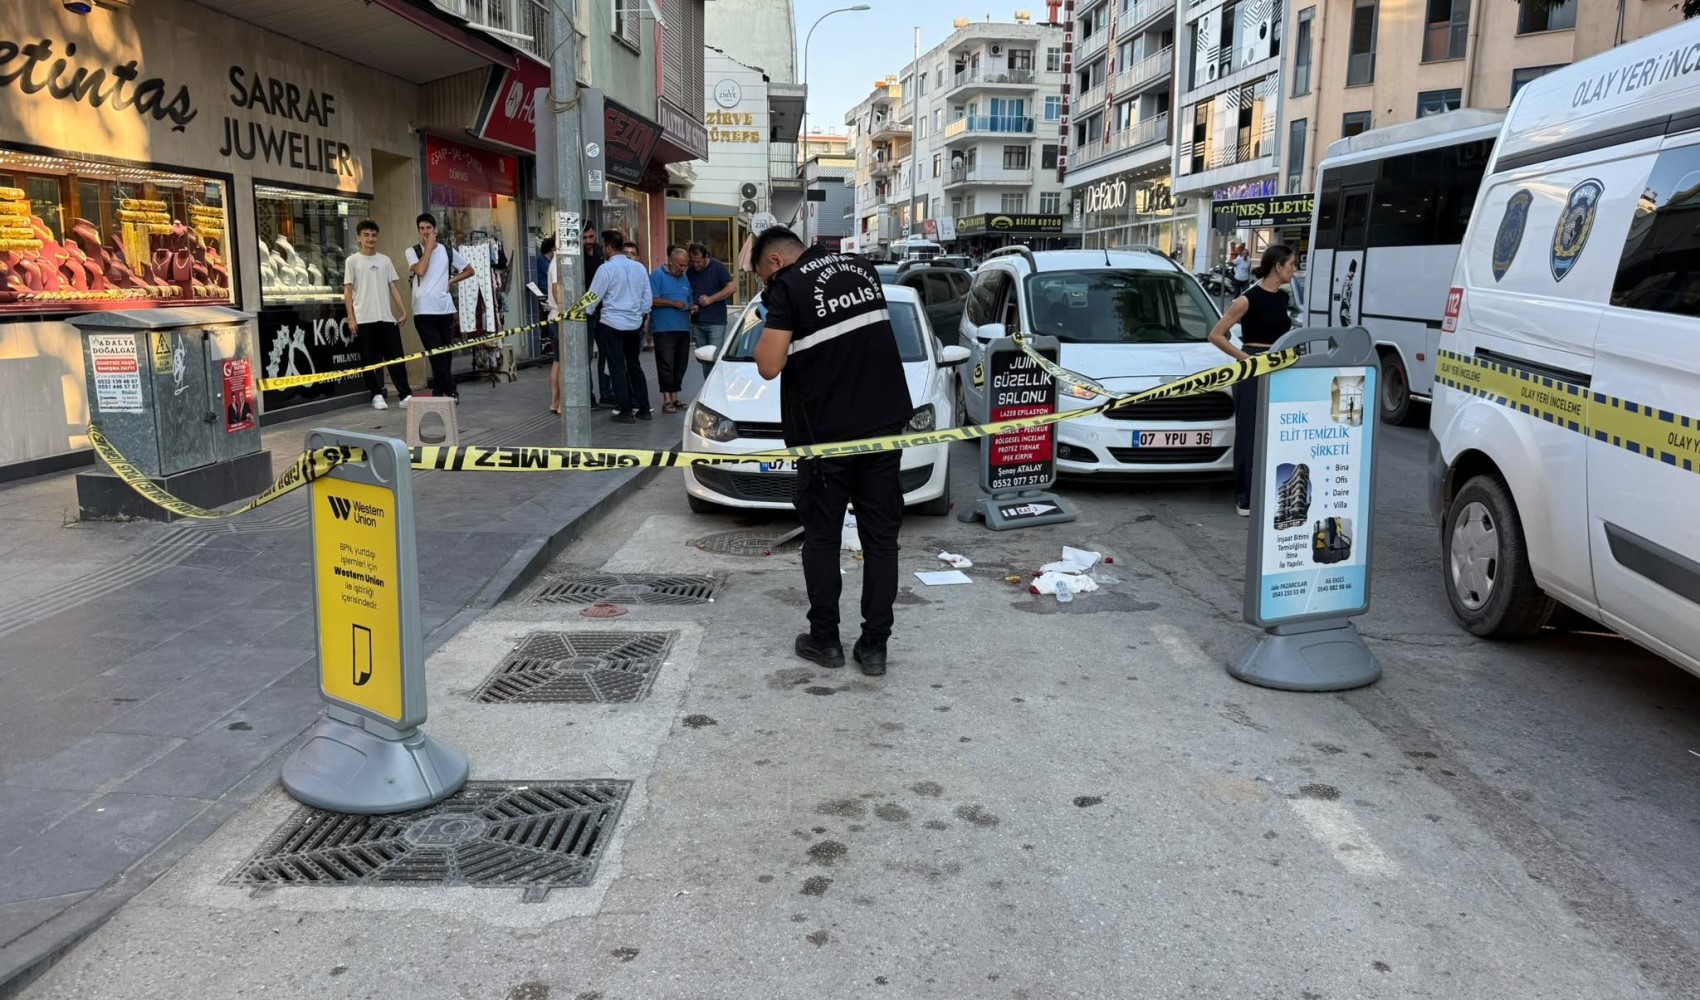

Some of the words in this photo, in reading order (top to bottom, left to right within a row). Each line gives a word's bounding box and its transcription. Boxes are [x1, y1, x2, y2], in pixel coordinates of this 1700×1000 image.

[1571, 70, 1619, 108] OLAY
[1617, 54, 1663, 94] YERİ
[229, 65, 336, 128] SARRAF
[706, 109, 753, 125] ZİRVE
[709, 126, 760, 144] ÜNEFE
[219, 117, 354, 178] JUWELIER
[1086, 177, 1126, 213] DeFacto
[816, 264, 838, 285] YERİ
[837, 263, 882, 299] İNCELEME
[814, 286, 827, 317] OLAY
[828, 286, 875, 313] POLİS
[92, 346, 136, 354] DOĞALGAZ
[994, 371, 1052, 388] GÜZELLİK
[998, 390, 1047, 405] SALONU
[1521, 386, 1536, 400] OLAY
[1536, 390, 1549, 404] YERİ
[1549, 393, 1582, 416] İNCELEME
[1017, 408, 1049, 416] EPİLASYON
[1280, 410, 1309, 425] SERİK
[995, 436, 1020, 445] BÖLGESEL
[1140, 433, 1155, 446] 07
[1164, 432, 1187, 446] YPU
[1195, 432, 1210, 446] 36
[1280, 428, 1301, 442] ELİT
[1303, 425, 1350, 441] TEMİZLİK
[998, 445, 1018, 453] PROTEZ
[1020, 444, 1041, 452] TIRNAK
[1667, 432, 1692, 452] OLAY
[475, 447, 641, 470] GİRİLMEZ
[1310, 444, 1350, 460] ŞİRKETİ
[998, 467, 1016, 477] Şenay
[1017, 464, 1043, 474] ATALAY
[1335, 463, 1350, 472] Bina
[992, 479, 1012, 489] 0552
[1013, 476, 1027, 486] 077
[1029, 475, 1038, 485] 57
[1040, 474, 1049, 483] 01
[1335, 475, 1348, 484] Ofis
[1332, 488, 1350, 497] Daire
[353, 500, 385, 518] Western
[1333, 500, 1348, 509] Villa
[354, 512, 377, 528] Union
[341, 554, 366, 569] işlemleri
[334, 566, 365, 581] Western
[365, 573, 385, 588] Union
[345, 581, 353, 591] ile
